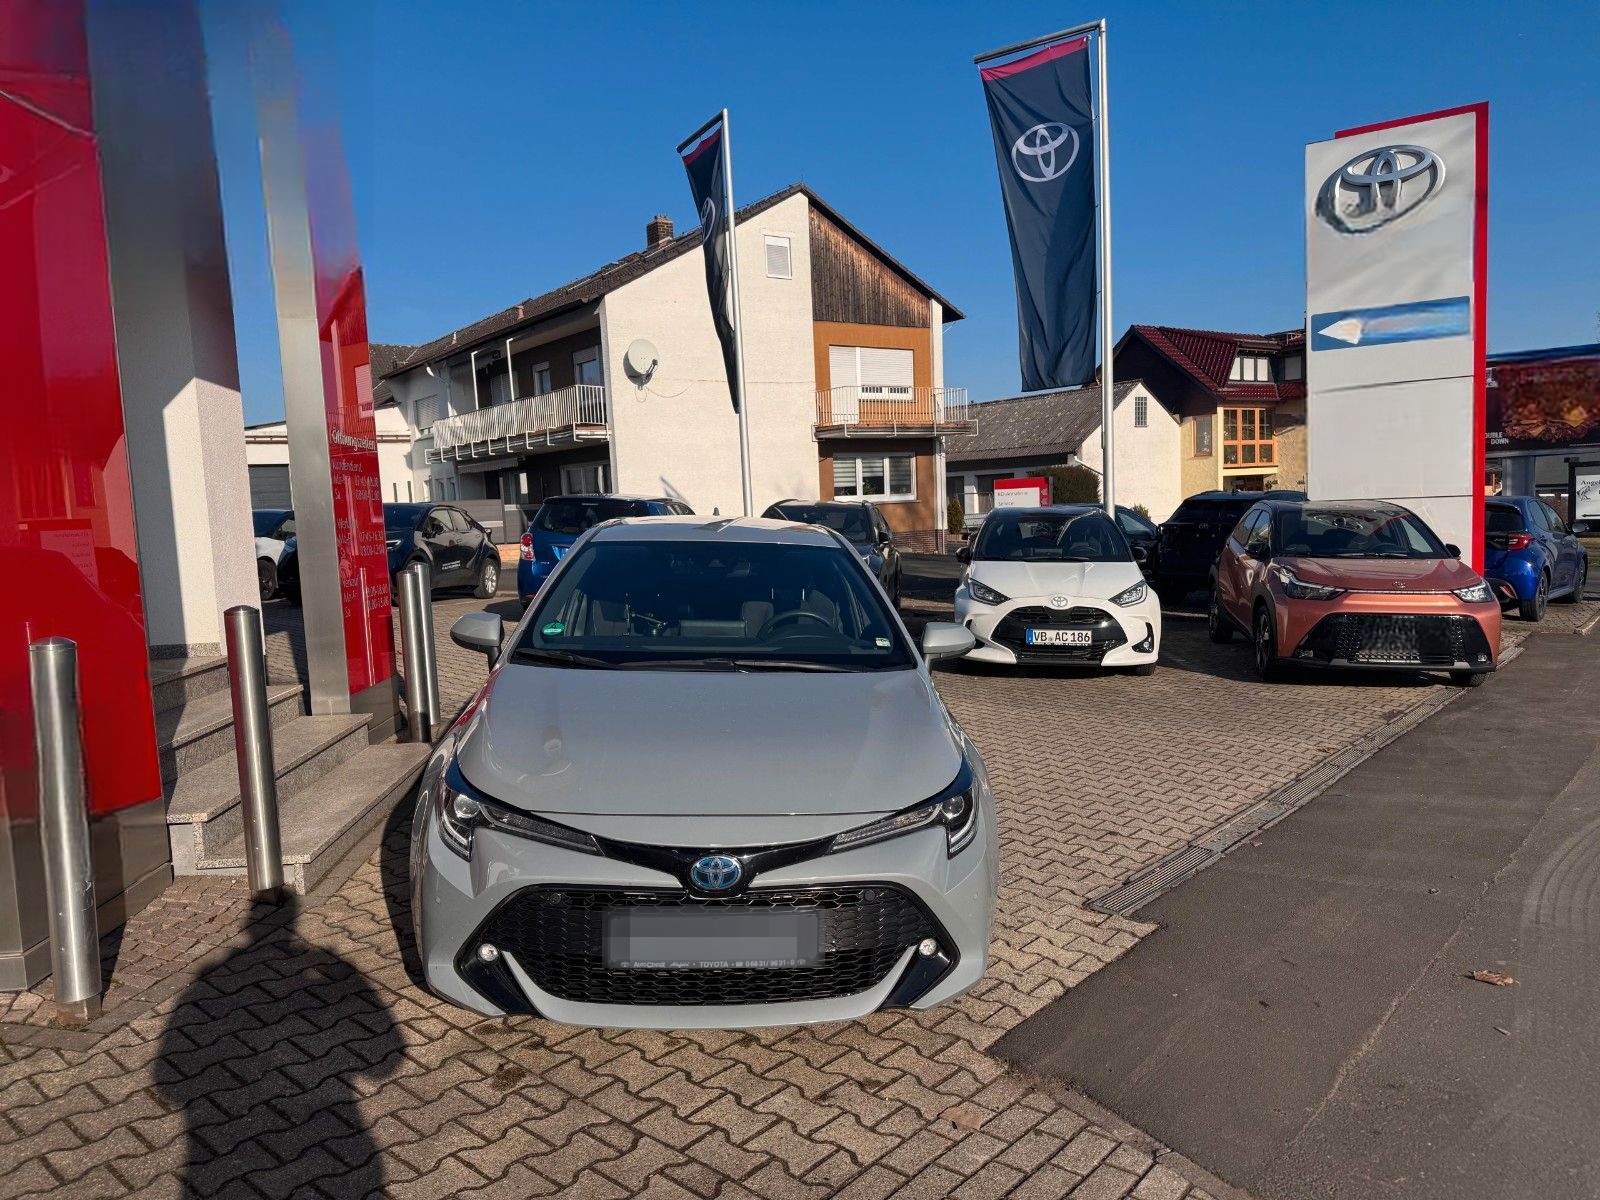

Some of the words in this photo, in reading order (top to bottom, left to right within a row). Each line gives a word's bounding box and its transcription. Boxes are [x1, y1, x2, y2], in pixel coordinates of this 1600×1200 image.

[1034, 631, 1048, 642] VB
[1054, 631, 1068, 642] AC
[1070, 632, 1091, 643] 186
